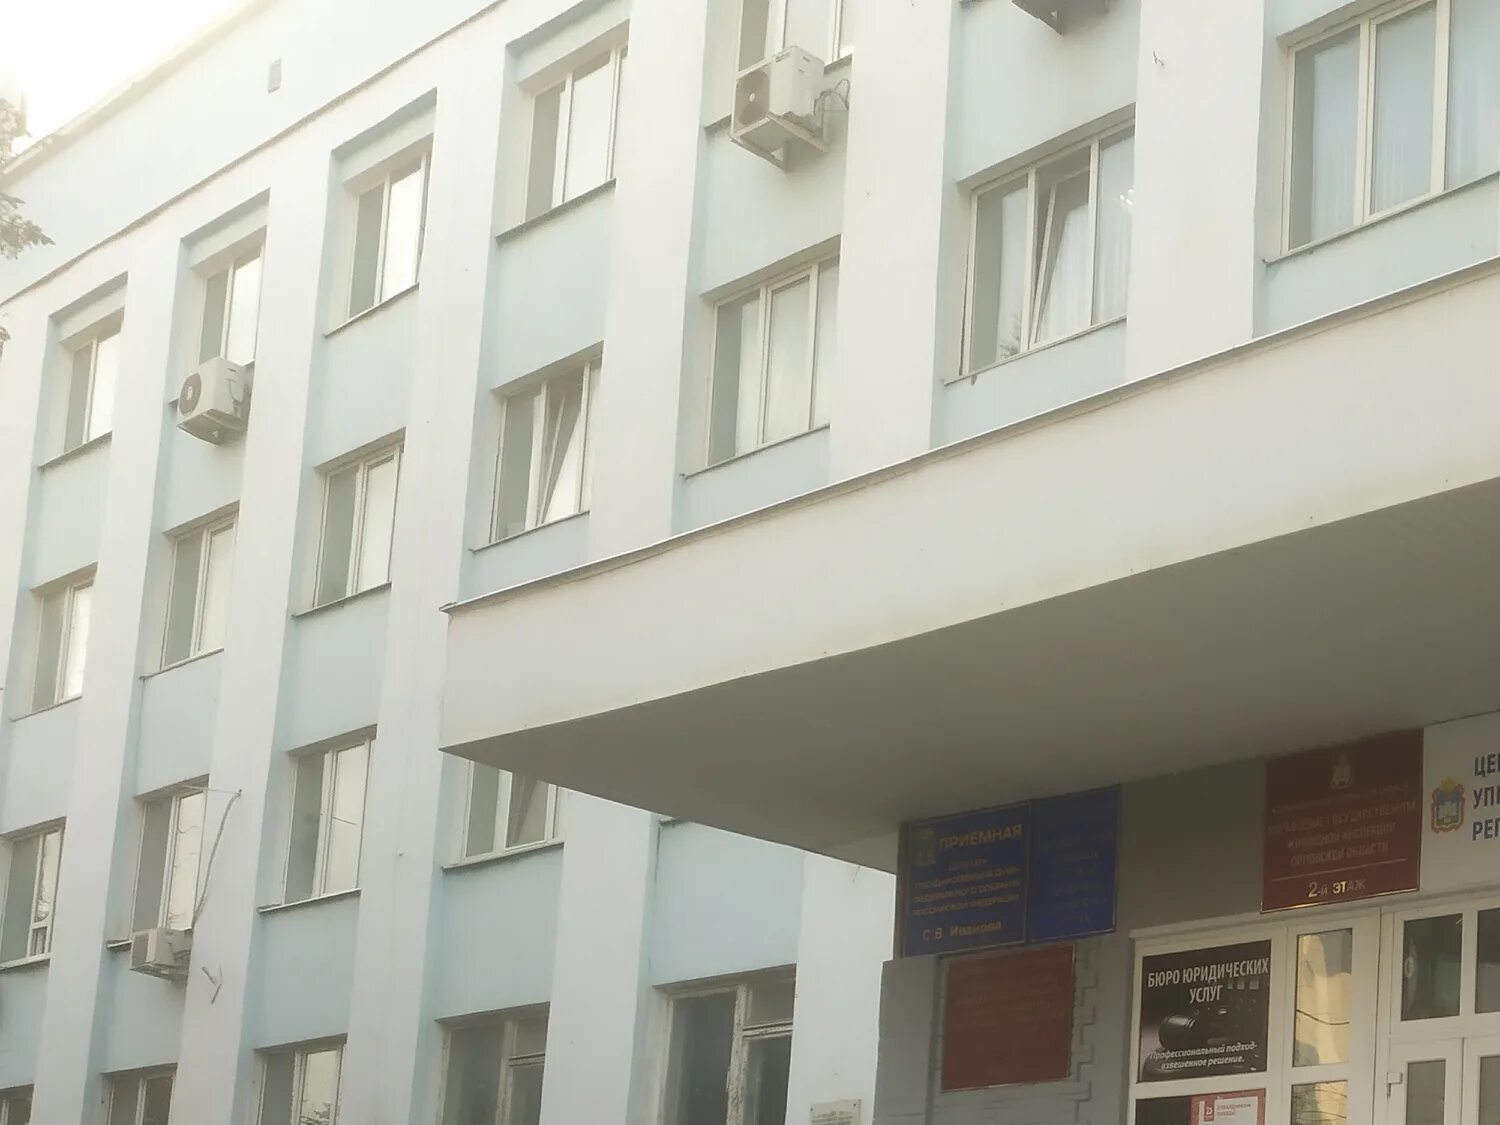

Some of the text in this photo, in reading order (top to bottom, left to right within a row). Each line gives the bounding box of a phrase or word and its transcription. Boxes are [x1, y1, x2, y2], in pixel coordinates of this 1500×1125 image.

[938, 823, 1024, 852] ПРИЕМНАЯ
[1332, 878, 1368, 895] ЭТАЖ
[1147, 957, 1270, 988] БЮРО ЮРИДИЧЕСКИХ
[1189, 984, 1224, 1005] УСЛУГ
